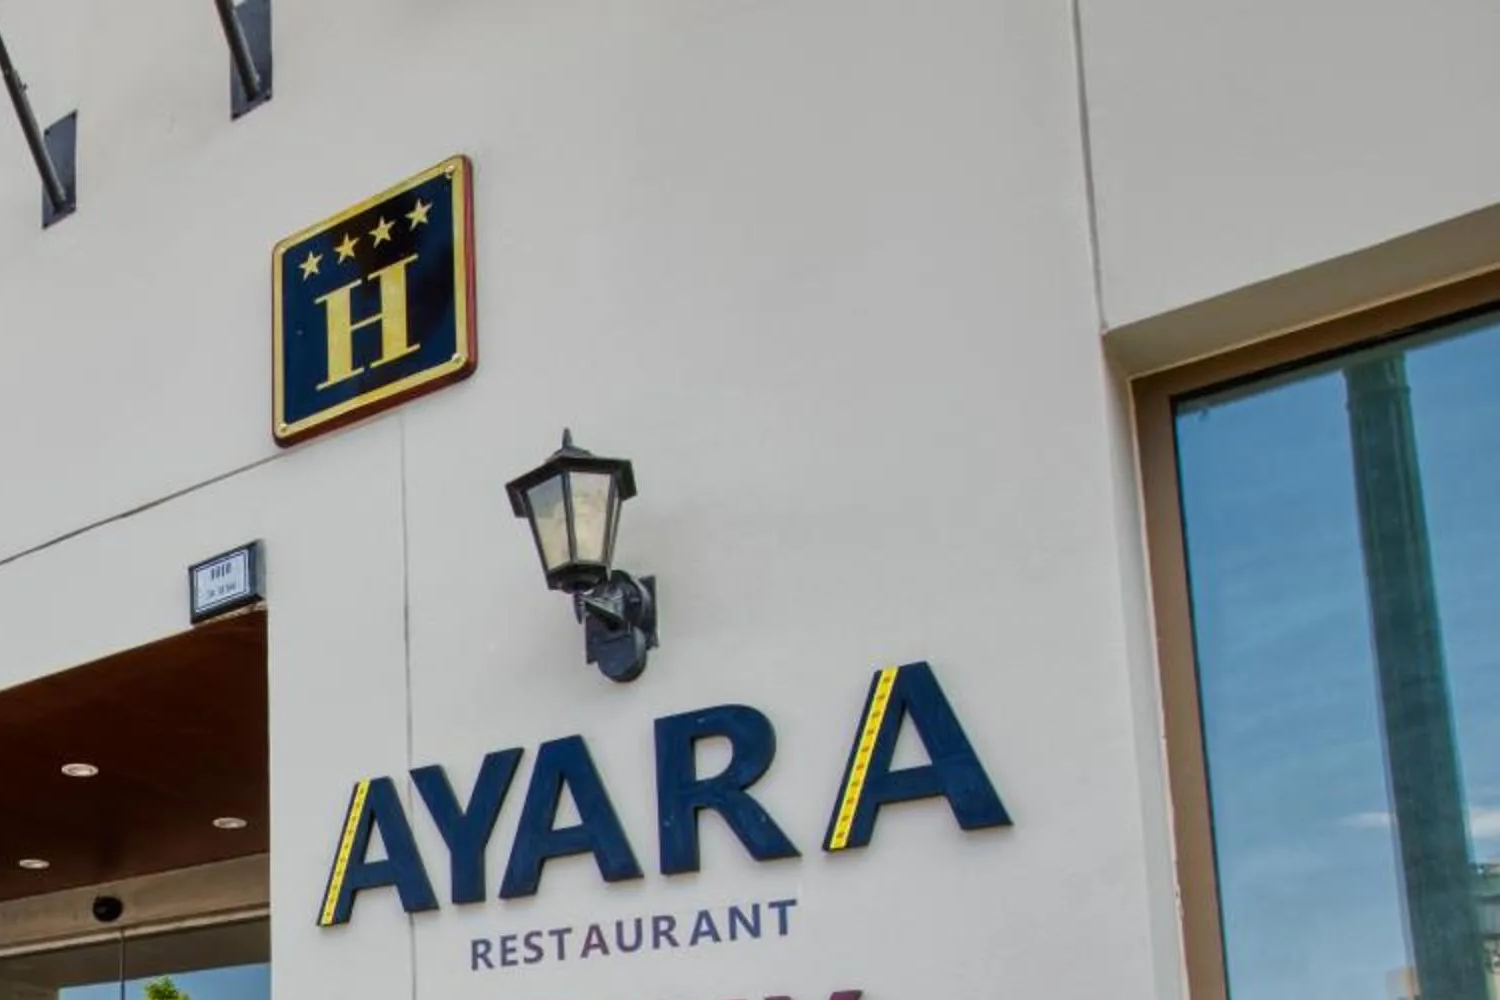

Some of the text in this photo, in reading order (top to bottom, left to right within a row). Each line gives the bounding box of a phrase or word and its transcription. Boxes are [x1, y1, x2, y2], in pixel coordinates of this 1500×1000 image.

[314, 253, 421, 390] H
[316, 660, 1014, 927] AYARA
[469, 898, 799, 972] RESTAURANT
